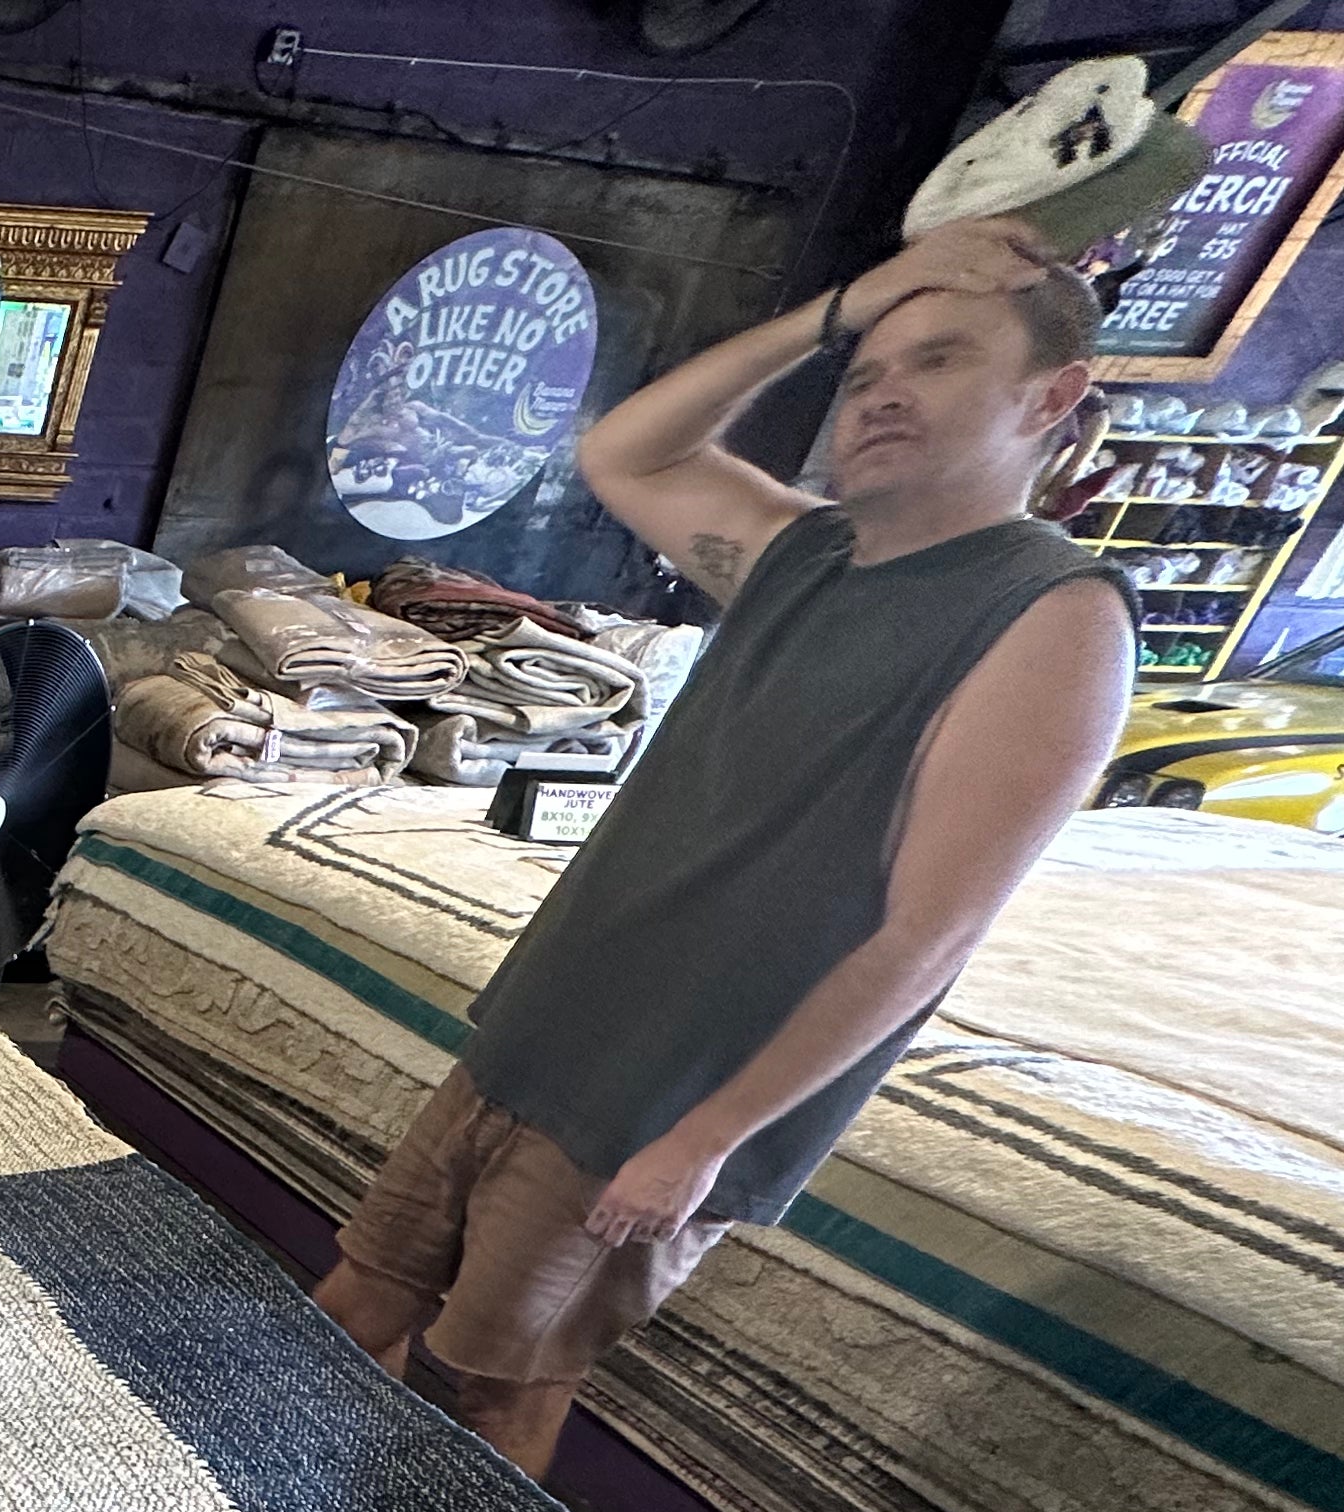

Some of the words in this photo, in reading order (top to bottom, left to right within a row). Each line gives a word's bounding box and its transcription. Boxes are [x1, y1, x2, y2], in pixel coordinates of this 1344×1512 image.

[1212, 140, 1291, 171] FFICIAL
[1216, 221, 1249, 236] HAT
[386, 296, 419, 336] A
[418, 247, 495, 307] RUG
[495, 249, 589, 344] STORE
[418, 303, 496, 347] LIKE
[493, 307, 548, 351] NO
[1100, 299, 1188, 331] FREE
[406, 346, 528, 394] OTHER
[541, 787, 613, 800] HANDWOVE
[564, 799, 595, 809] JUTE
[581, 812, 599, 823] 9X
